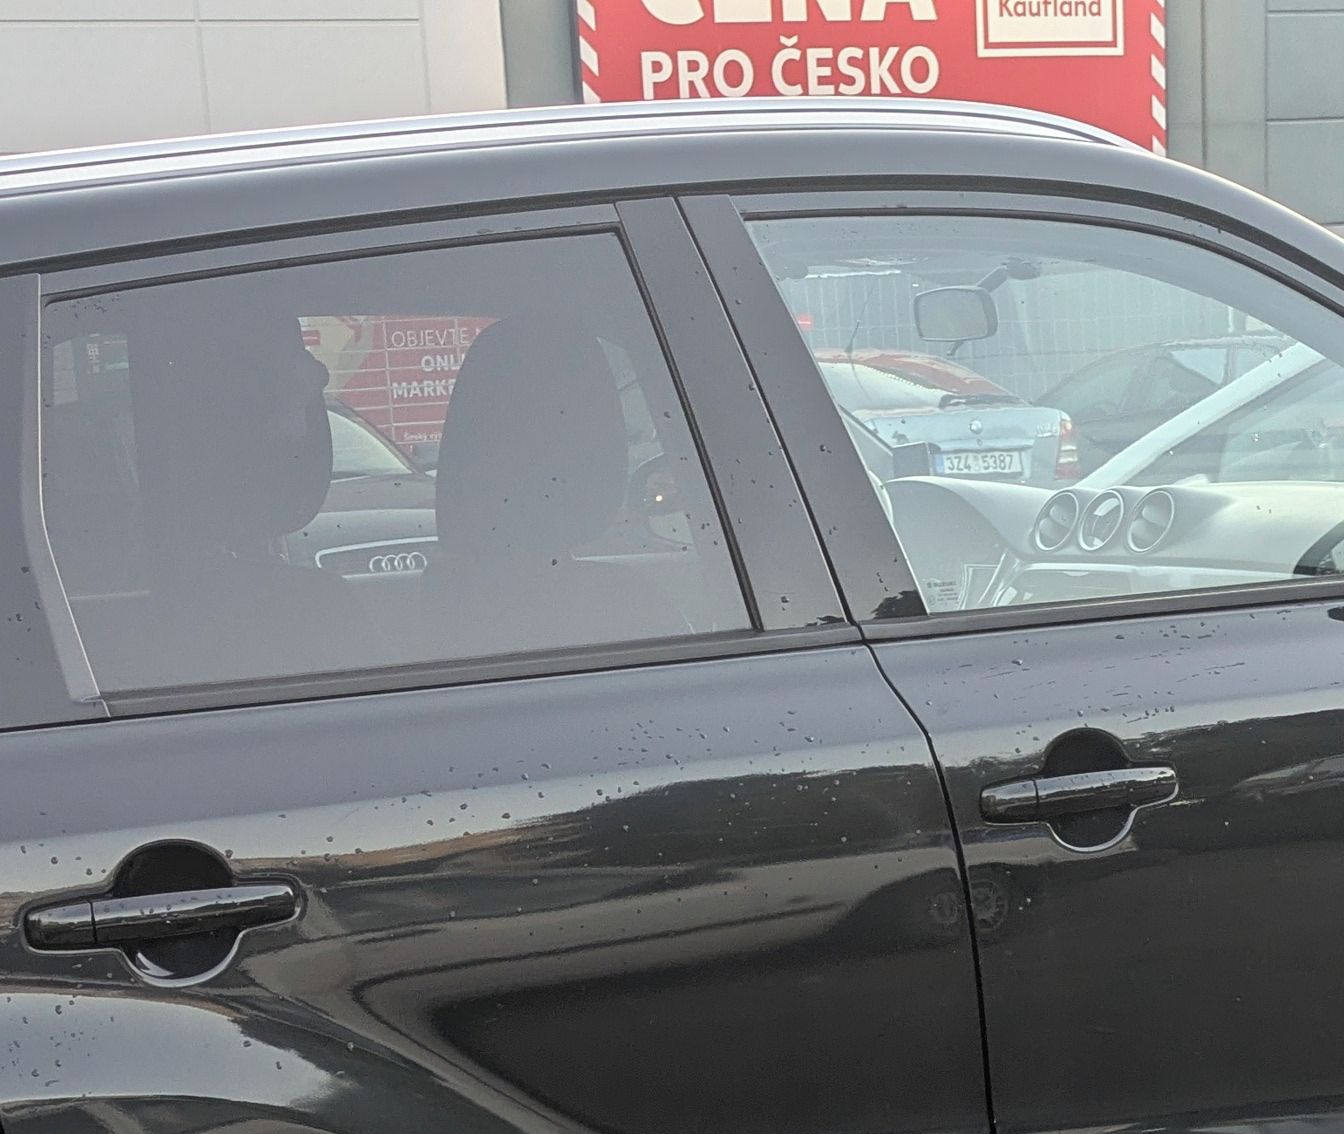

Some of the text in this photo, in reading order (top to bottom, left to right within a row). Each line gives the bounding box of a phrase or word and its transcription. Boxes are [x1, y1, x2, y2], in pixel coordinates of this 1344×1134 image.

[999, 0, 1102, 17] Kaufland
[640, 34, 940, 100] PRO ČESKO
[391, 328, 470, 347] OBJEVTE
[947, 455, 1013, 471] 3Z4 5387
